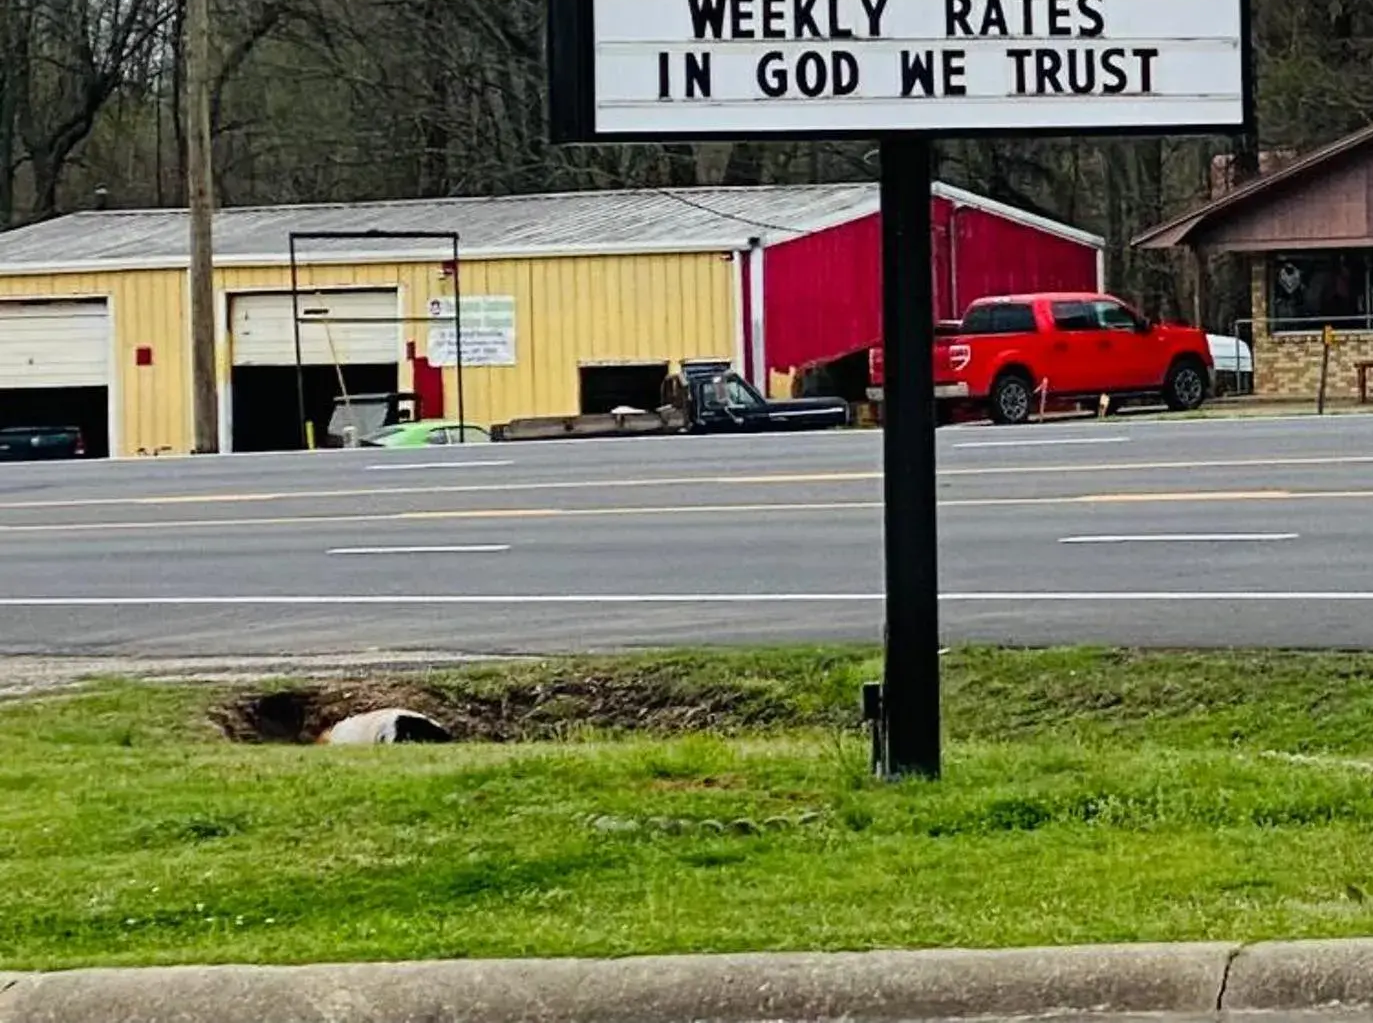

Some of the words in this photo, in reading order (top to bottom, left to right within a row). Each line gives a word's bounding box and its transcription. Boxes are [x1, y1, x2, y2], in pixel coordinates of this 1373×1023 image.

[657, 51, 711, 100] IN
[756, 50, 859, 97] GOD
[900, 49, 966, 97] WE
[1006, 48, 1159, 95] TRUST
